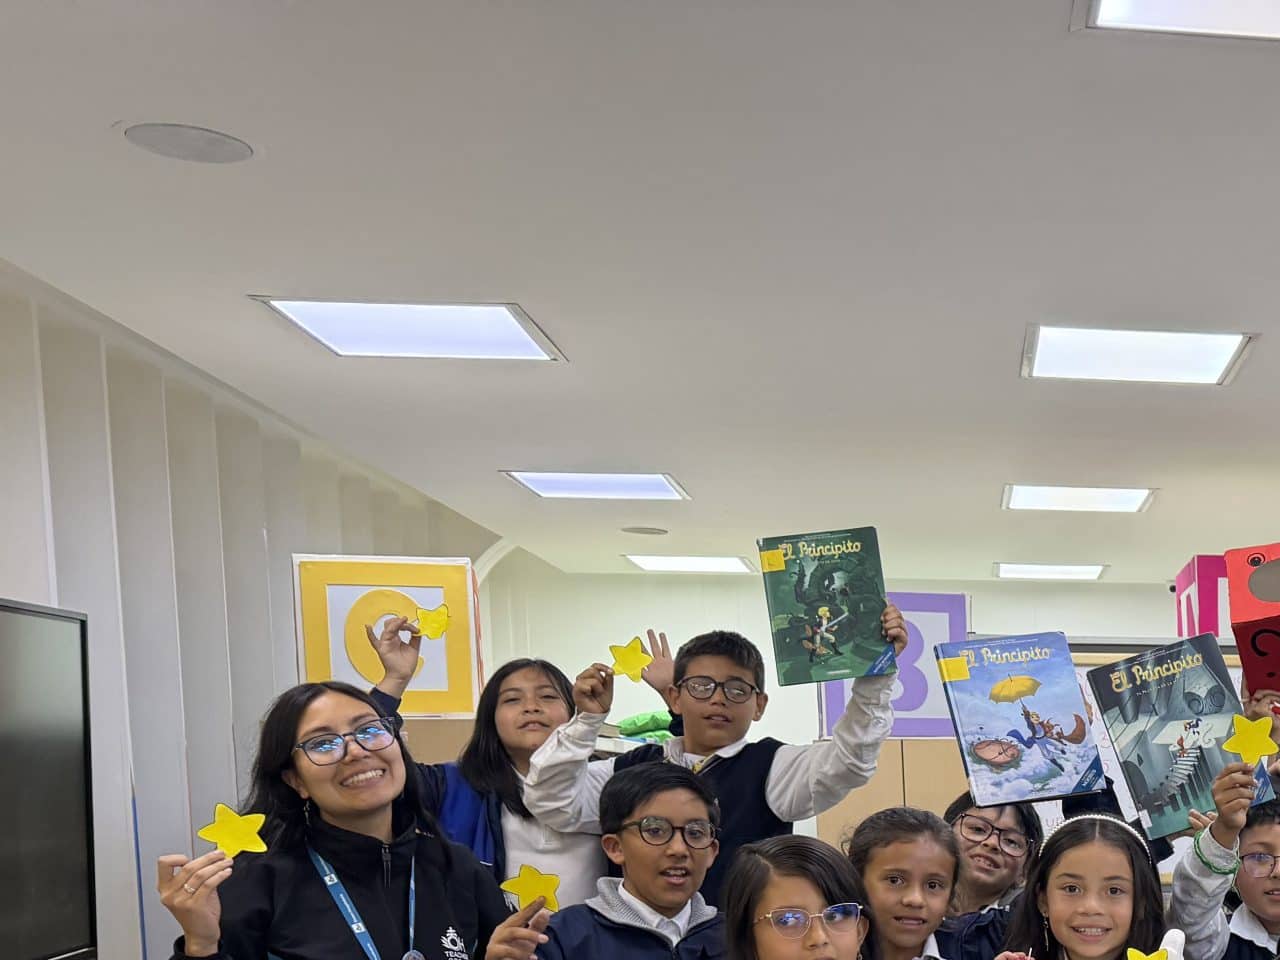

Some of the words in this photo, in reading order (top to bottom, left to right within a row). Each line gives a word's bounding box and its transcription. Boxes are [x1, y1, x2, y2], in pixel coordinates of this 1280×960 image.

[798, 540, 861, 559] Principito
[981, 646, 1051, 667] Principito
[1110, 671, 1133, 693] El
[1131, 653, 1203, 686] Principito
